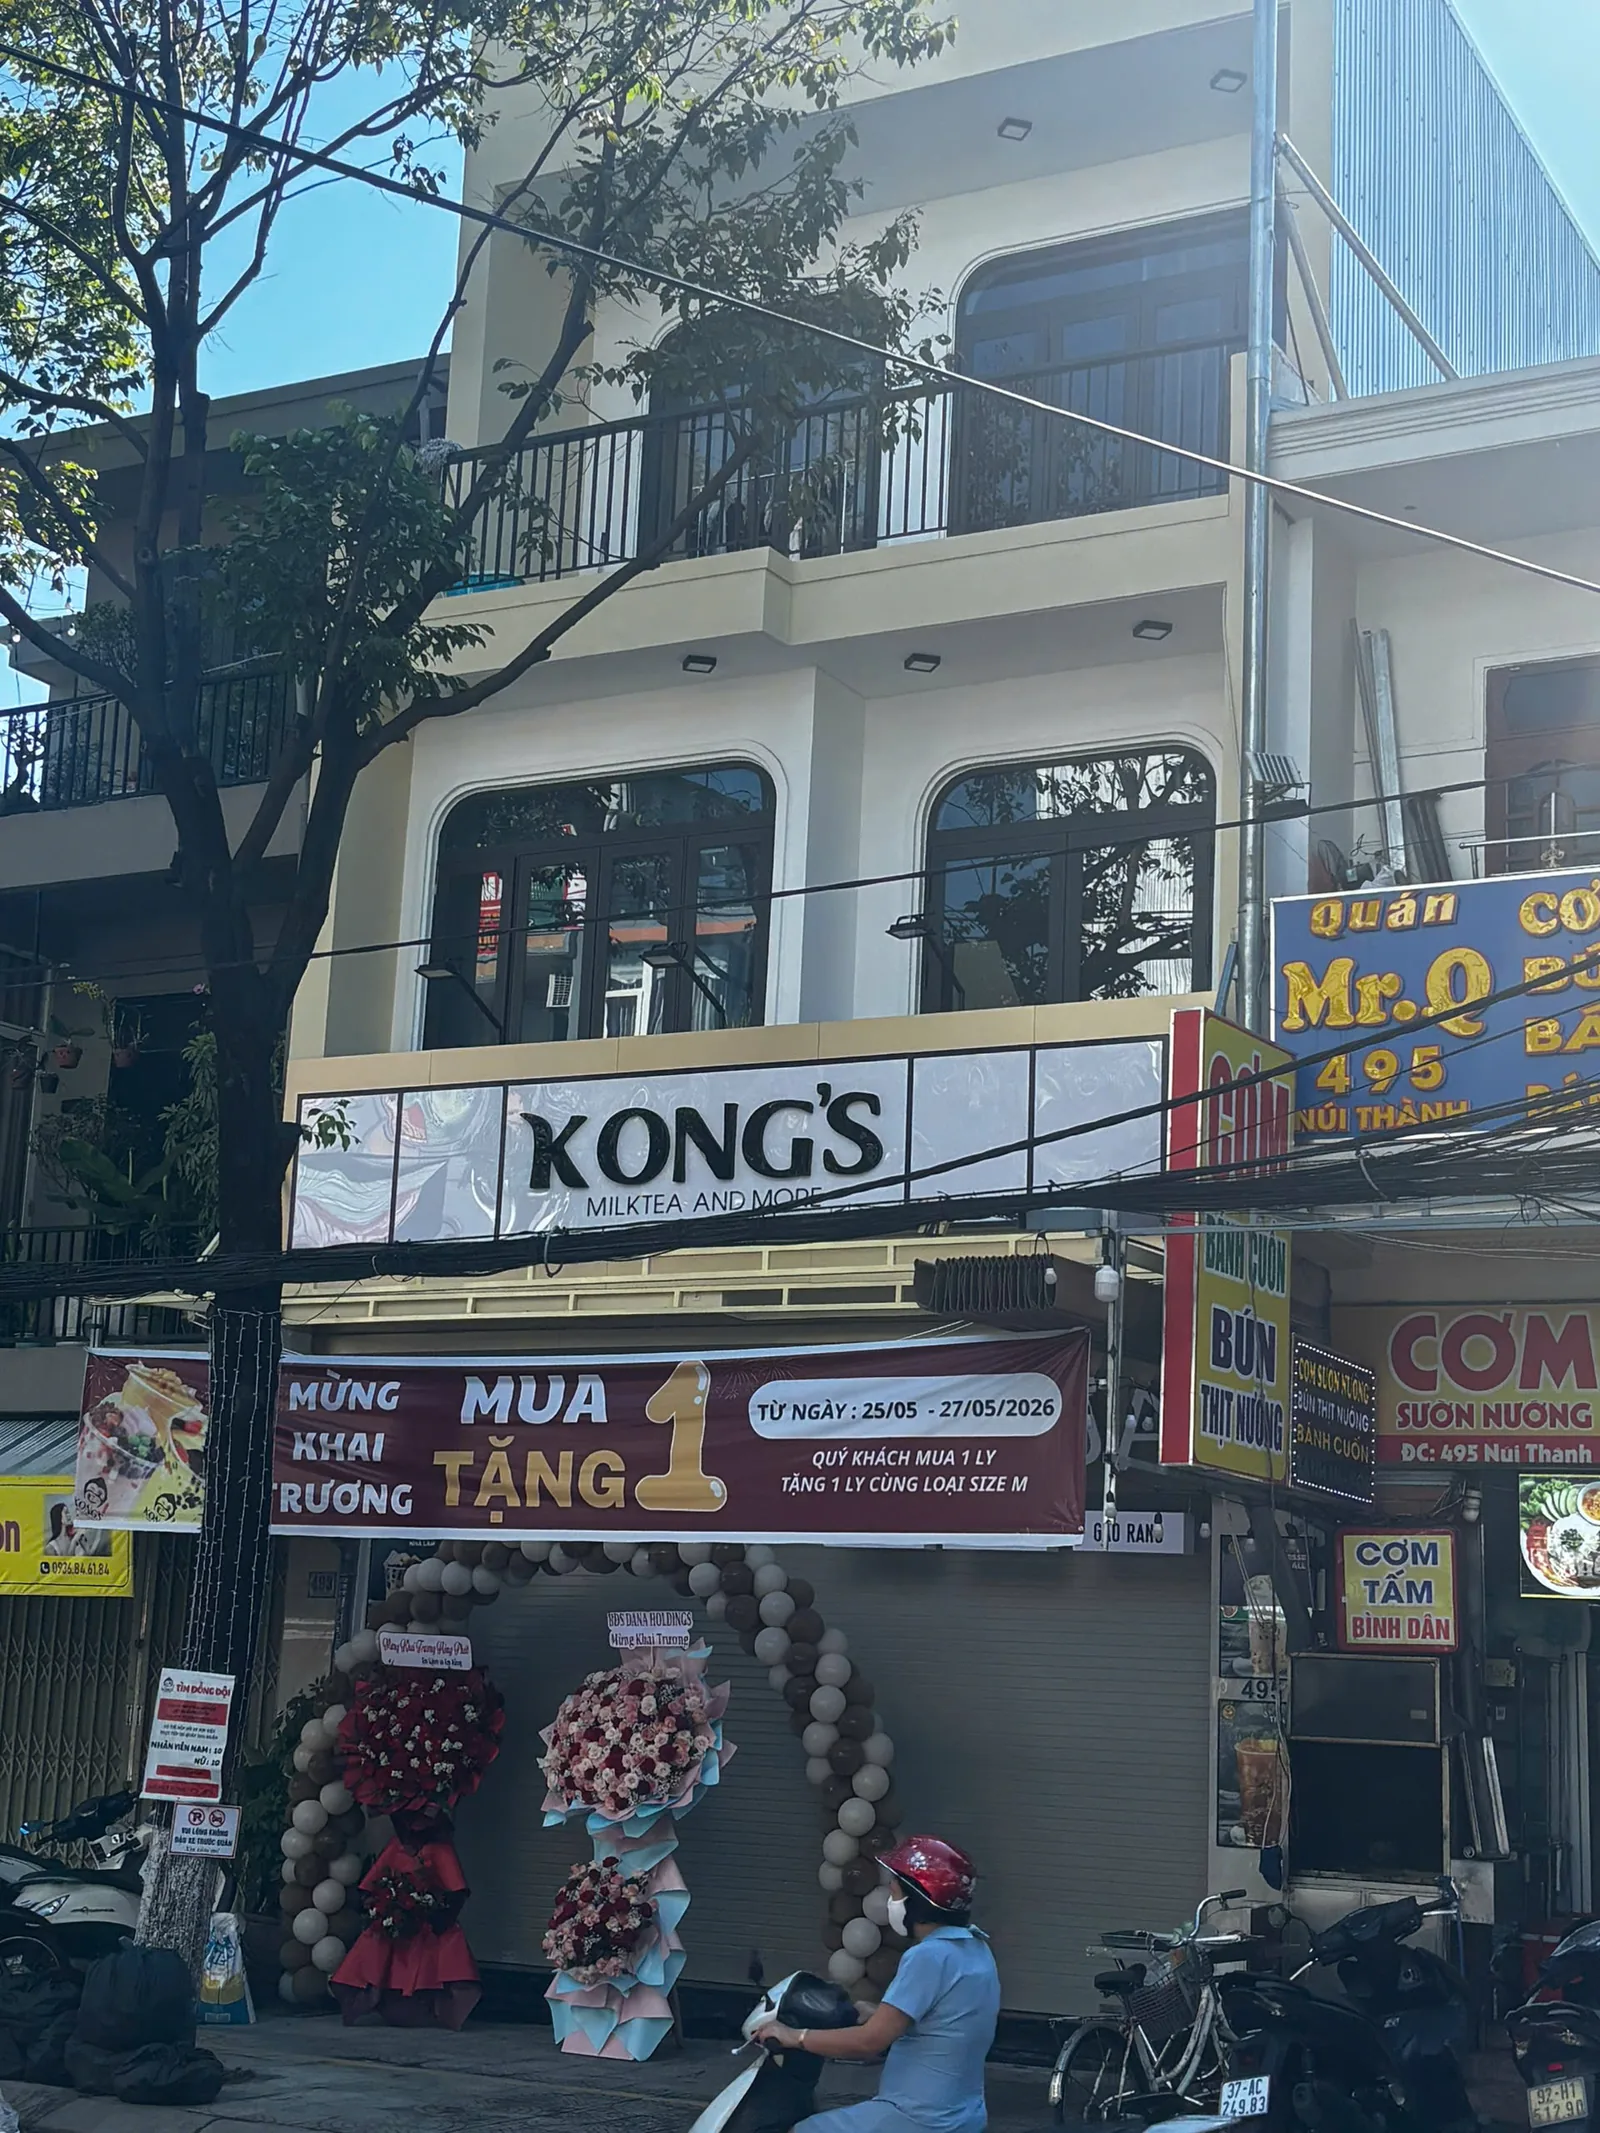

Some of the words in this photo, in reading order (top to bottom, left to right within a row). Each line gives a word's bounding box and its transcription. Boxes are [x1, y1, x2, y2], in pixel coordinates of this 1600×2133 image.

[1282, 947, 1492, 1037] Mr.Q
[1315, 1046, 1445, 1095] 495
[1295, 1102, 1349, 1132] NÚI
[520, 1082, 884, 1190] KONG'S
[587, 1193, 683, 1217] MILKTEA
[693, 1190, 746, 1213] AND
[1212, 1304, 1277, 1384] BÚN
[1389, 1311, 1598, 1392] CƠM
[289, 1368, 401, 1411] MỪNG
[460, 1374, 608, 1424] MUA
[757, 1400, 786, 1420] TỪ
[792, 1399, 847, 1420] NGÀY
[851, 1406, 857, 1419] :
[862, 1401, 917, 1419] 25/05
[939, 1398, 1055, 1417] 27/05/2026
[1201, 1384, 1233, 1448] THỊT
[1397, 1400, 1475, 1429] SƯỜN
[1482, 1399, 1593, 1429] NƯỚNG
[293, 1432, 385, 1461] KHAI
[634, 1359, 728, 1513] 1
[812, 1446, 848, 1469] QUÝ
[852, 1446, 910, 1466] KHÁCH
[915, 1450, 955, 1466] MUA
[962, 1450, 970, 1466] 1
[975, 1450, 997, 1466] LY
[1401, 1443, 1435, 1462] ĐC:
[1440, 1443, 1478, 1462] 495
[1484, 1443, 1520, 1462] Núi
[433, 1435, 626, 1523] TẶNG
[781, 1472, 826, 1496] TẶNG
[832, 1476, 840, 1492] 1
[845, 1476, 865, 1492] LY
[869, 1472, 919, 1492] CÙNG
[923, 1476, 966, 1495] LOẠI
[969, 1476, 1007, 1492] SIZE
[1011, 1476, 1028, 1492] M
[272, 1479, 413, 1515] RƯƠNG
[1127, 1523, 1163, 1543] RAN
[1356, 1539, 1438, 1566] CƠM
[52, 1562, 110, 1575] 0936.84.61.84
[1363, 1569, 1432, 1604] TẤM
[650, 1611, 692, 1627] HOLDINGS
[1352, 1612, 1400, 1639] BÌNH
[1407, 1613, 1450, 1640] DÂN
[1227, 2079, 1263, 2099] 37-AC
